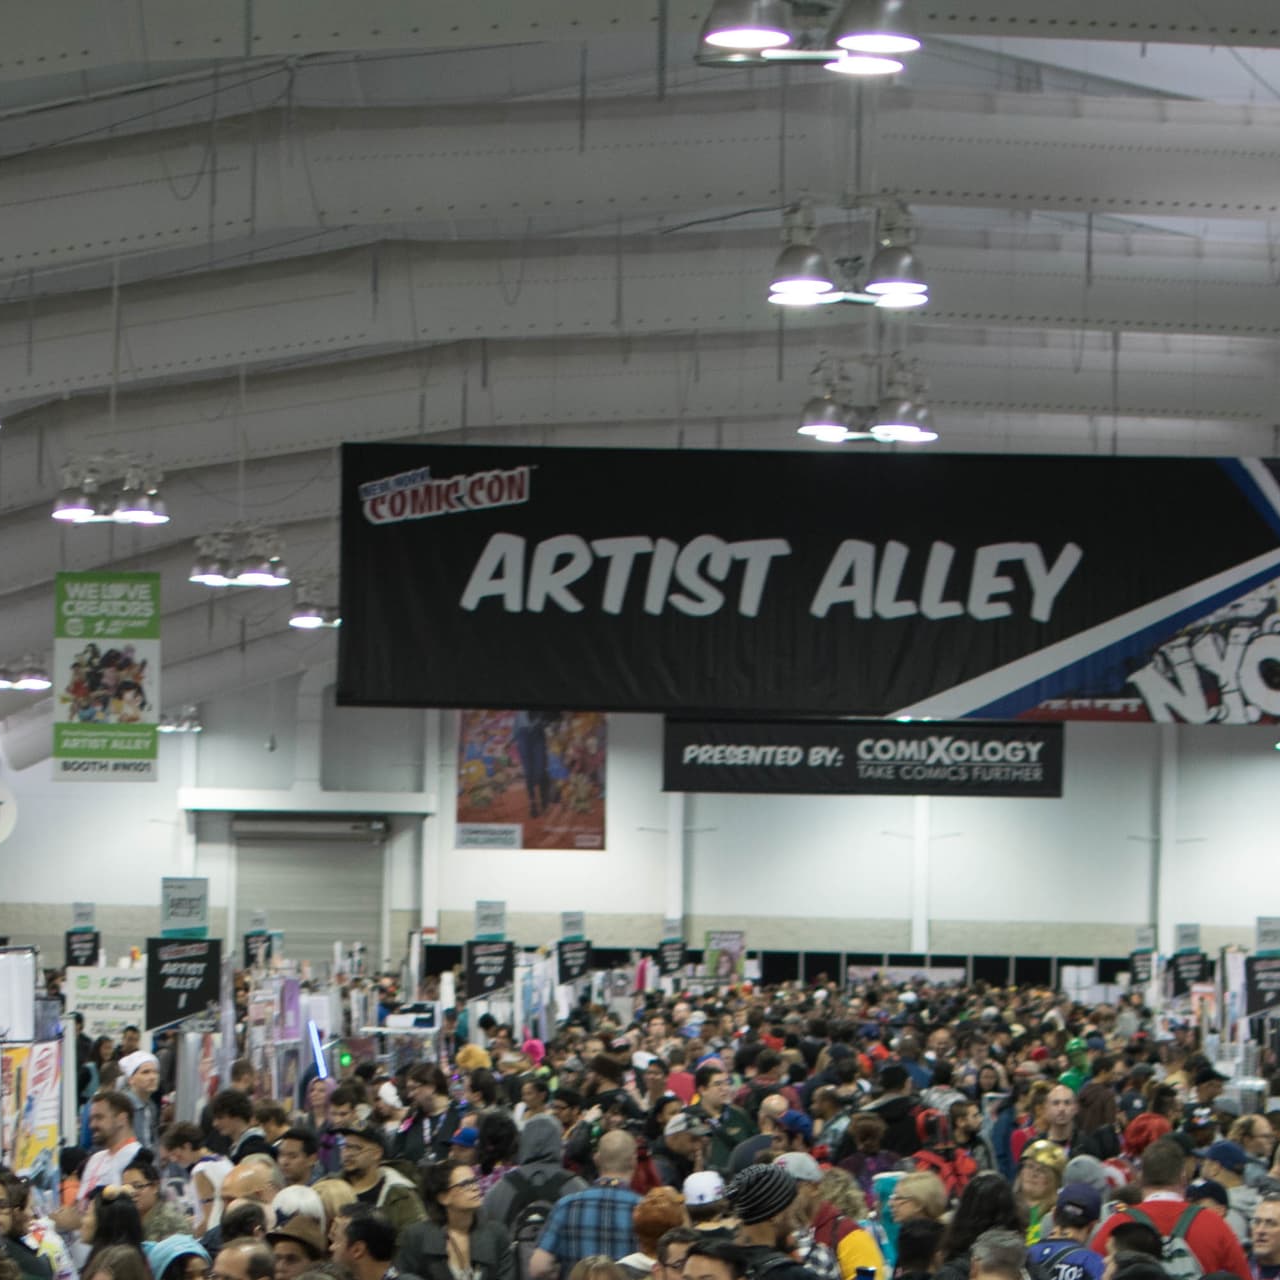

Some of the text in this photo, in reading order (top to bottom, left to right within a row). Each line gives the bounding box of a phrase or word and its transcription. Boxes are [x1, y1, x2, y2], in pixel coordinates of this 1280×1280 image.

[368, 471, 527, 521] COMIC CON
[459, 532, 1084, 623] ARTIST ALLEY
[65, 583, 99, 600] WE
[61, 601, 155, 617] CREATORS
[61, 738, 152, 750] ARTIST ALLEY
[682, 744, 843, 768] PRESENTED BY:
[62, 761, 109, 772] BOOTH
[858, 765, 1043, 782] TAKE COMICS FURTHER
[160, 962, 207, 976] ARTIST
[163, 976, 204, 989] ALLEY
